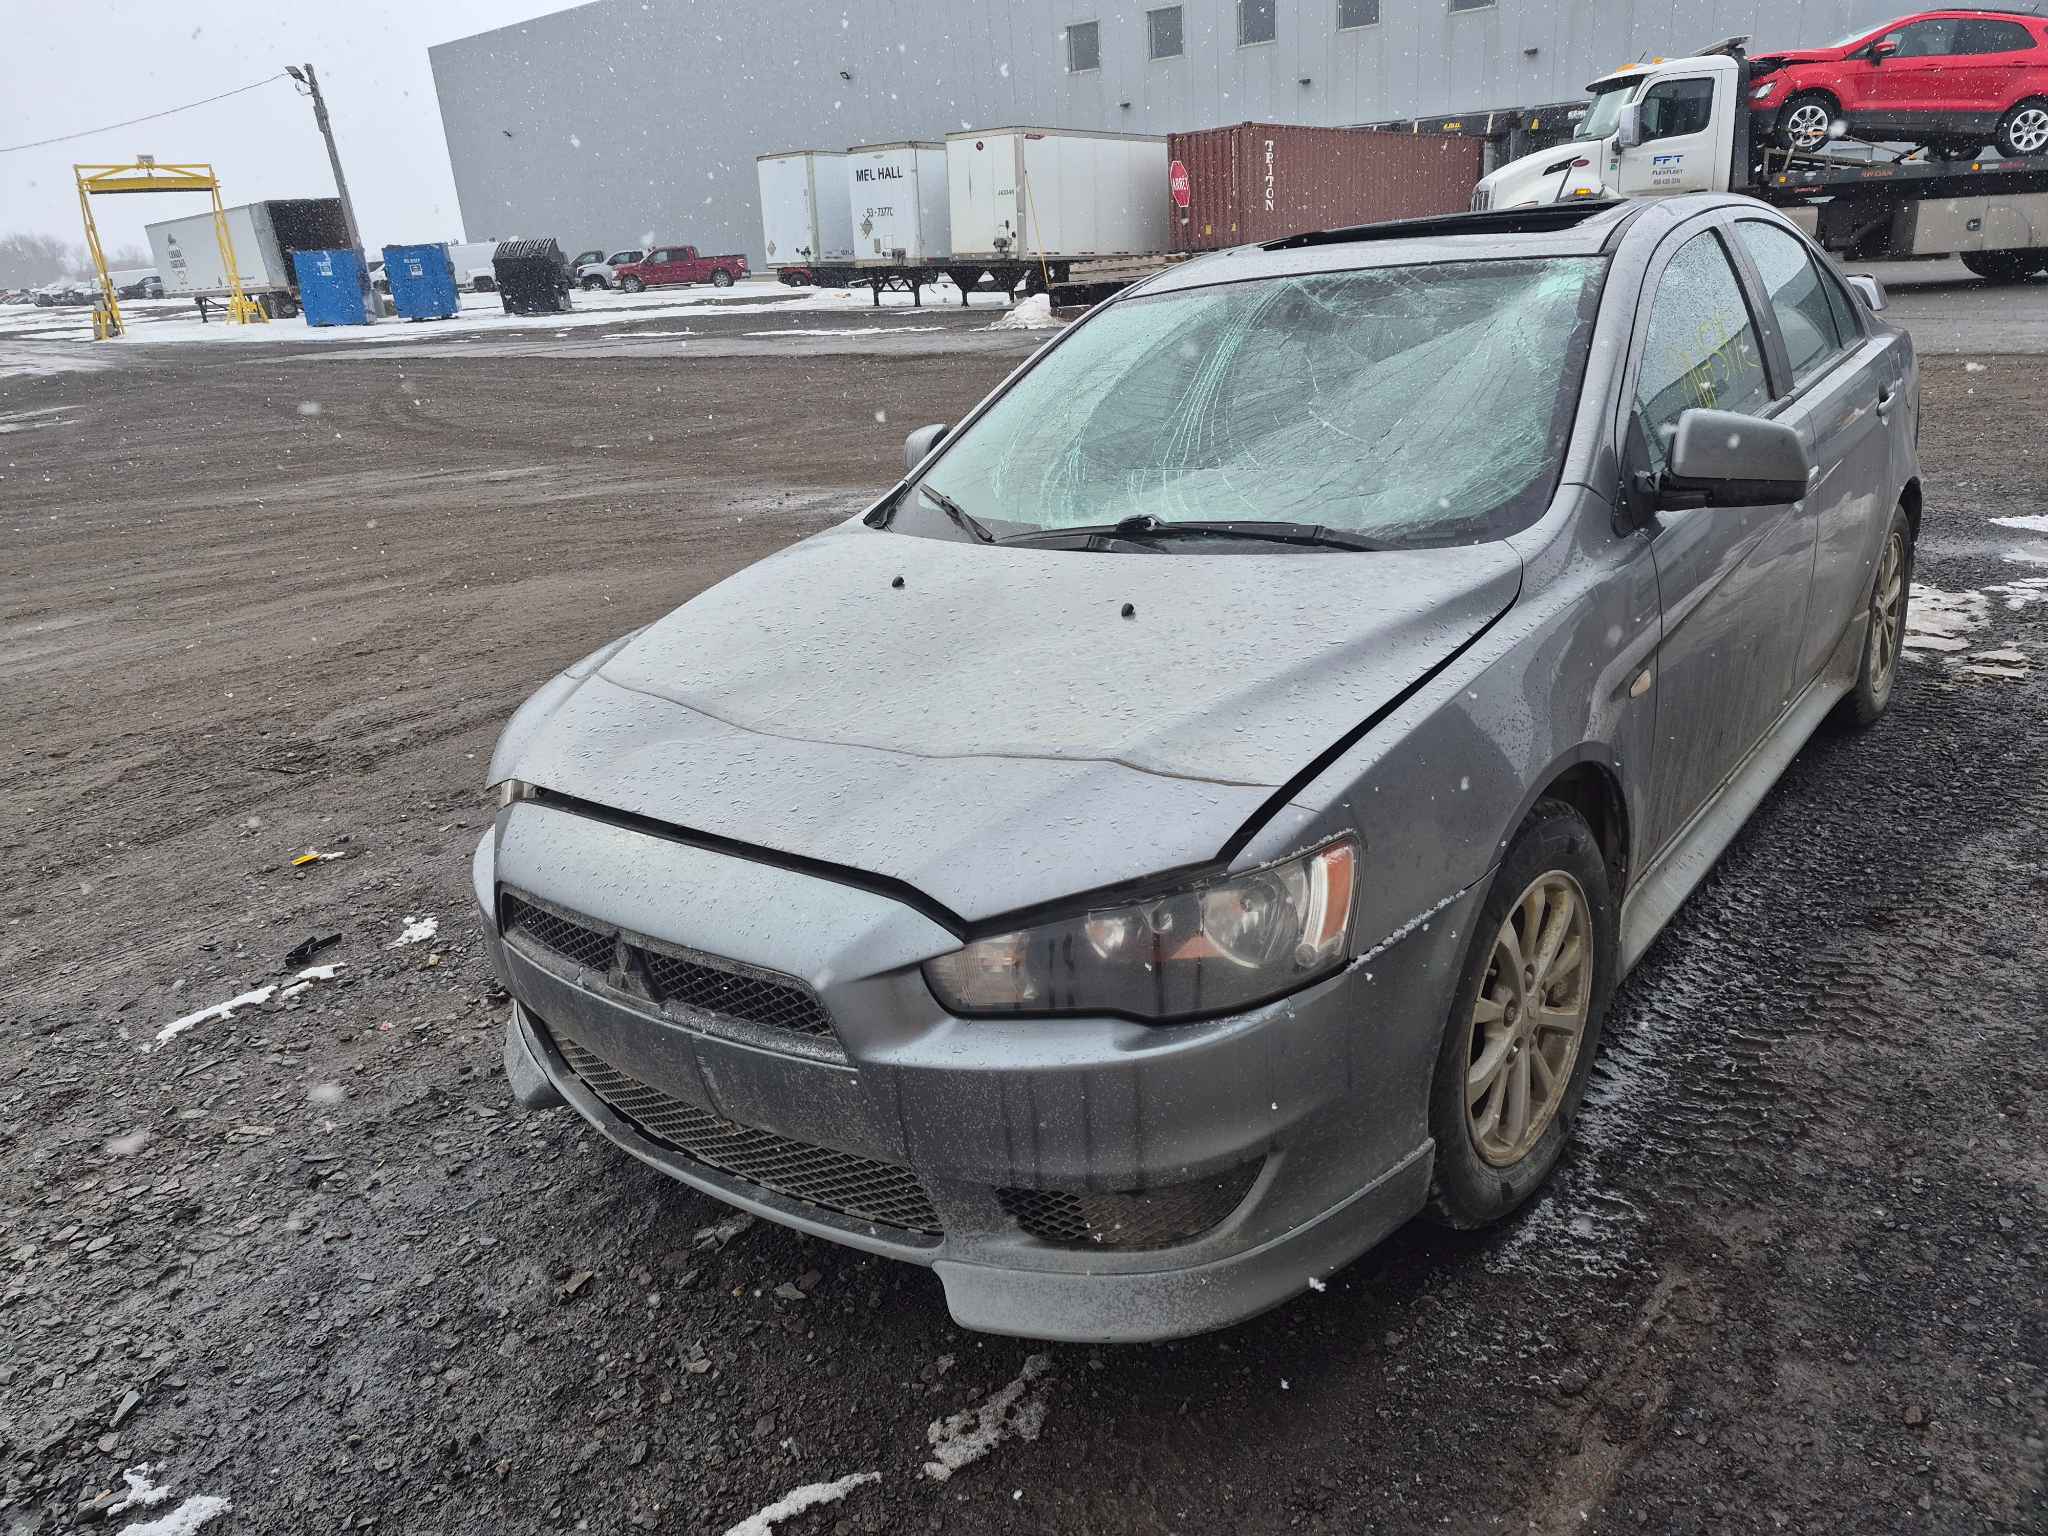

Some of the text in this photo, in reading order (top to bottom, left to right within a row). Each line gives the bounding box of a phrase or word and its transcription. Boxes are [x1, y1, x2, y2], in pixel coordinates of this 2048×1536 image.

[1653, 154, 1684, 165] FFT
[856, 166, 903, 182] MEL HALL
[1264, 140, 1274, 211] TRITON
